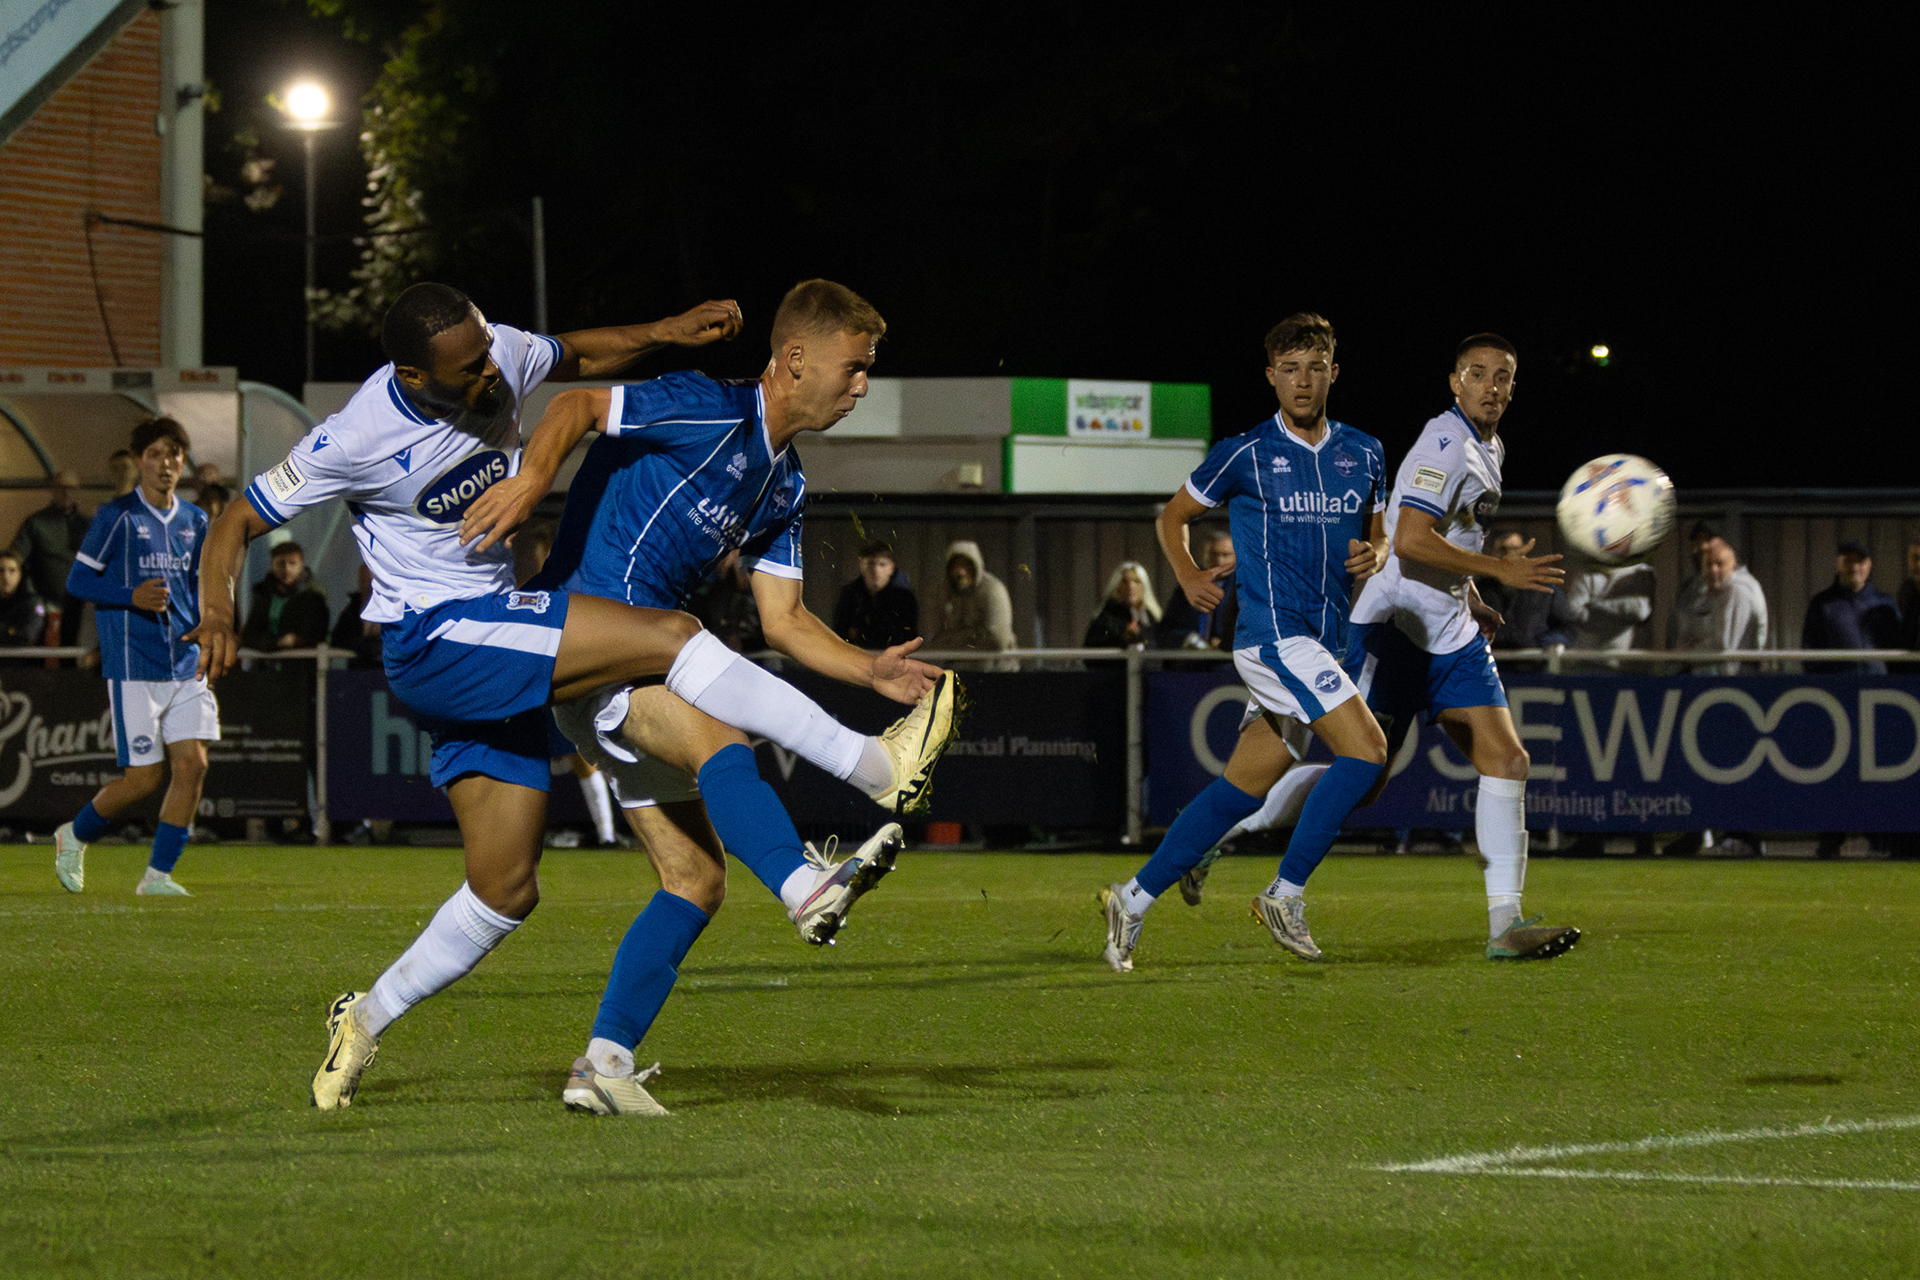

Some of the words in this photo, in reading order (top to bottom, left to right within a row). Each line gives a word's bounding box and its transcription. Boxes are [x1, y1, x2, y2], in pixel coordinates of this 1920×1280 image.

[426, 457, 505, 515] SNOWS
[1279, 491, 1342, 514] utilita
[1280, 514, 1295, 523] life
[1296, 514, 1317, 523] with
[1316, 516, 1341, 524] power
[138, 552, 182, 570] utilita
[1010, 735, 1097, 762] Planning
[1425, 788, 1454, 812] Air
[1612, 788, 1692, 822] Experts
